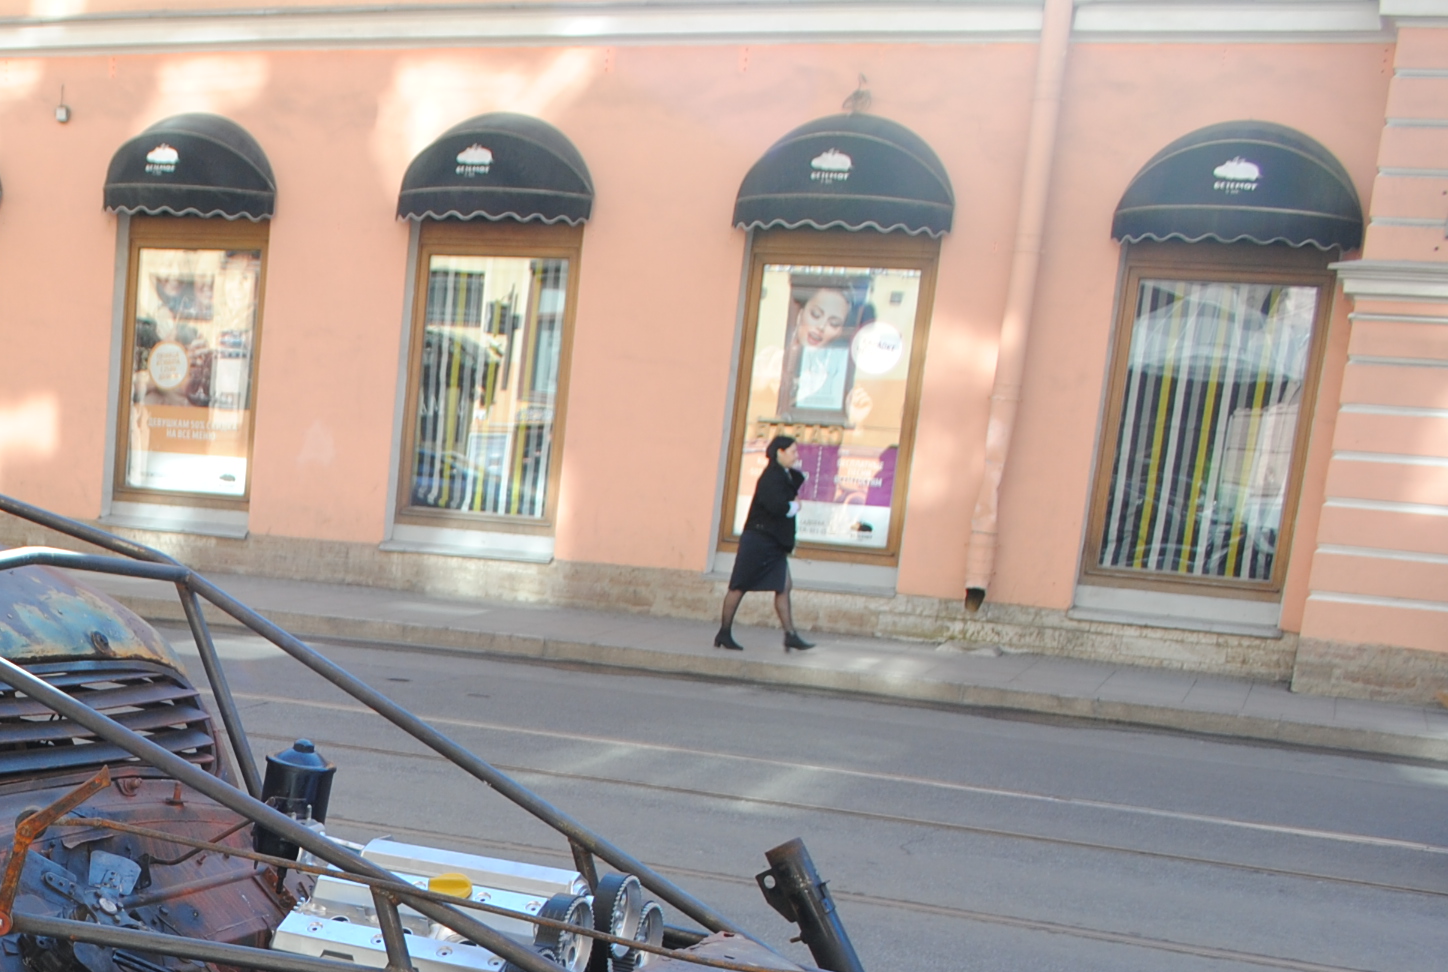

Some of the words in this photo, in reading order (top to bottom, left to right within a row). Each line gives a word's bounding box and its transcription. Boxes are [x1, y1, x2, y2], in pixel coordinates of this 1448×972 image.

[148, 416, 190, 428] ДЕВУШКАМ
[190, 419, 206, 429] 50%
[166, 428, 176, 437] НА
[177, 429, 191, 440] ВСЕ
[192, 430, 217, 441] МЕНЮ
